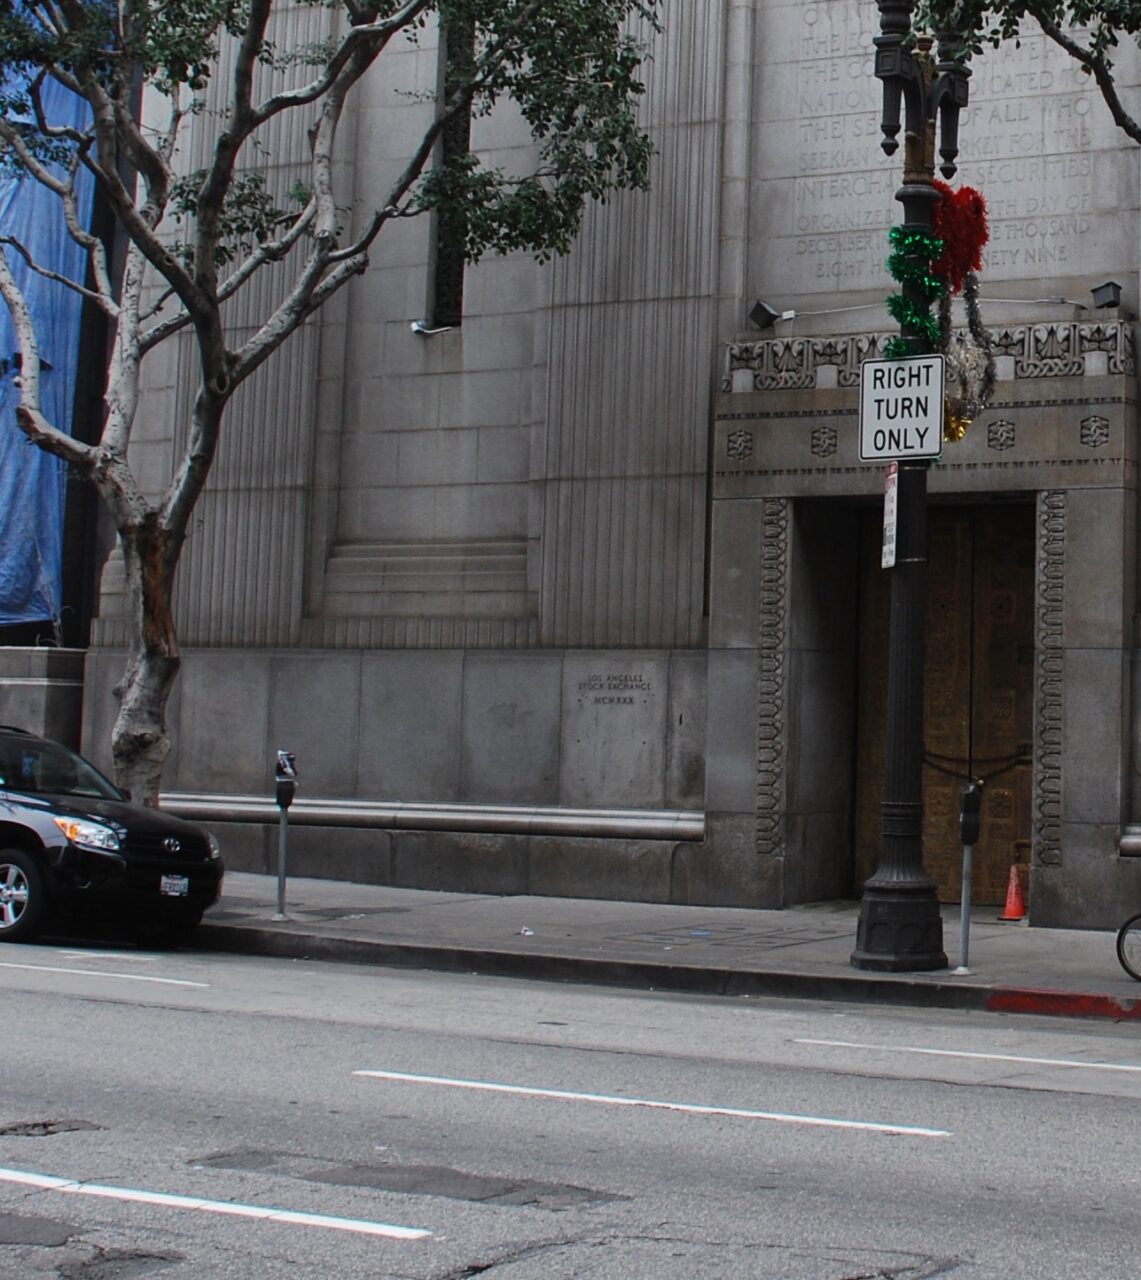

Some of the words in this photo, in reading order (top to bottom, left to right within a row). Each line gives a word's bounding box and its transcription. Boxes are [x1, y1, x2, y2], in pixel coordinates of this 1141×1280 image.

[803, 33, 840, 55] THE
[801, 63, 839, 84] THE
[969, 70, 1054, 96] DICATED
[800, 120, 842, 142] THE
[988, 104, 1030, 124] ALL
[1042, 97, 1091, 121] WHO
[960, 135, 1004, 157] RKET
[1053, 127, 1091, 148] THE
[797, 176, 895, 200] INTERCHA
[976, 157, 1091, 185] SECURITIES
[797, 209, 896, 231] ORGANIZED
[1026, 195, 1061, 213] DAY
[1066, 194, 1090, 210] OF
[797, 235, 873, 255] DECEMBER
[1005, 220, 1090, 239] THOUSAND
[816, 261, 865, 278] EIGHT
[1024, 245, 1068, 263] NINE
[873, 364, 933, 390] RIGHT
[874, 396, 928, 420] TURN
[873, 427, 929, 452] ONLY
[606, 673, 643, 683] ANGELES
[608, 682, 652, 690] EXCHANGE
[594, 696, 634, 705] MCMXXX
